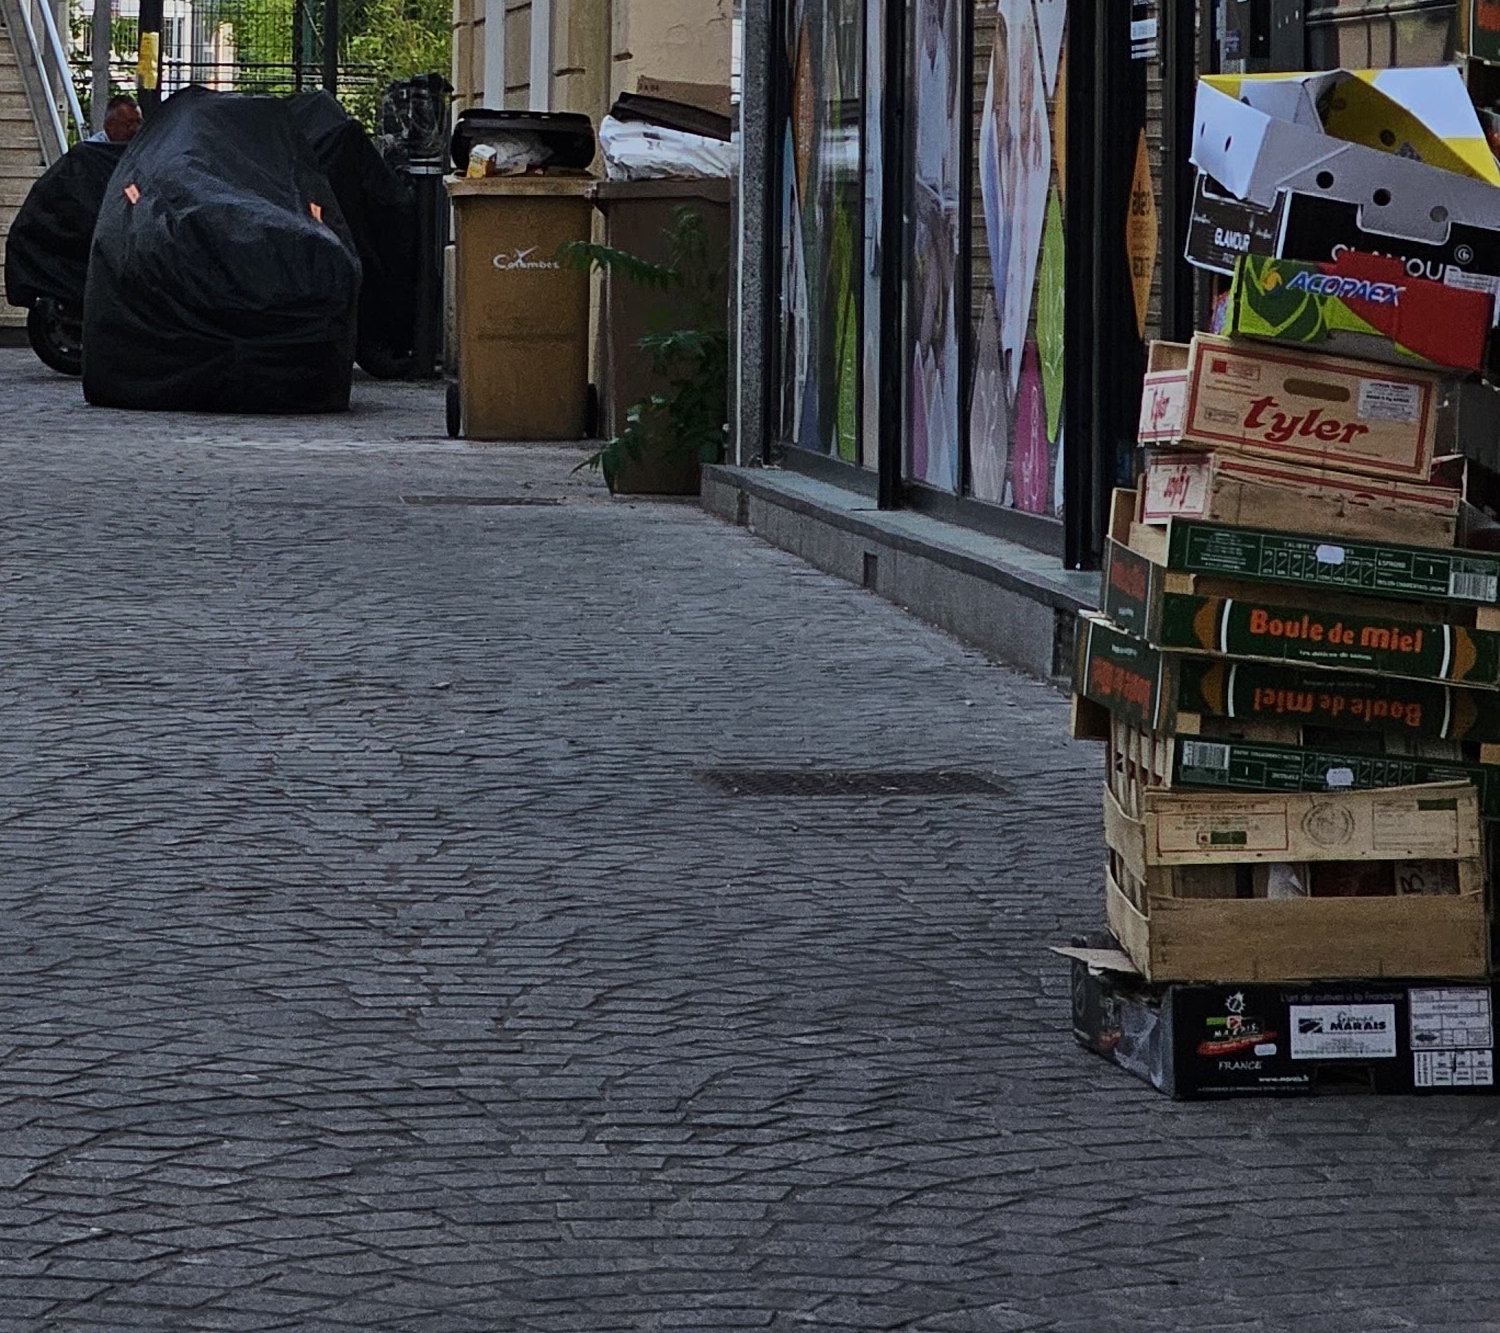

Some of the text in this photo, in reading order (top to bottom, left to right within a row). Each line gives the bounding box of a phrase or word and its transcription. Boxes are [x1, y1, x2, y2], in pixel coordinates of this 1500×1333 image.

[1214, 227, 1250, 252] GLAMOUR
[1287, 271, 1407, 307] ACOPAEX
[1243, 395, 1370, 444] tyler
[1250, 608, 1324, 641] Boule
[1327, 620, 1355, 645] de
[1319, 698, 1347, 721] de
[1350, 700, 1422, 727] Boule
[1330, 1020, 1387, 1032] MARAIS
[1218, 1060, 1263, 1071] FRANCE
